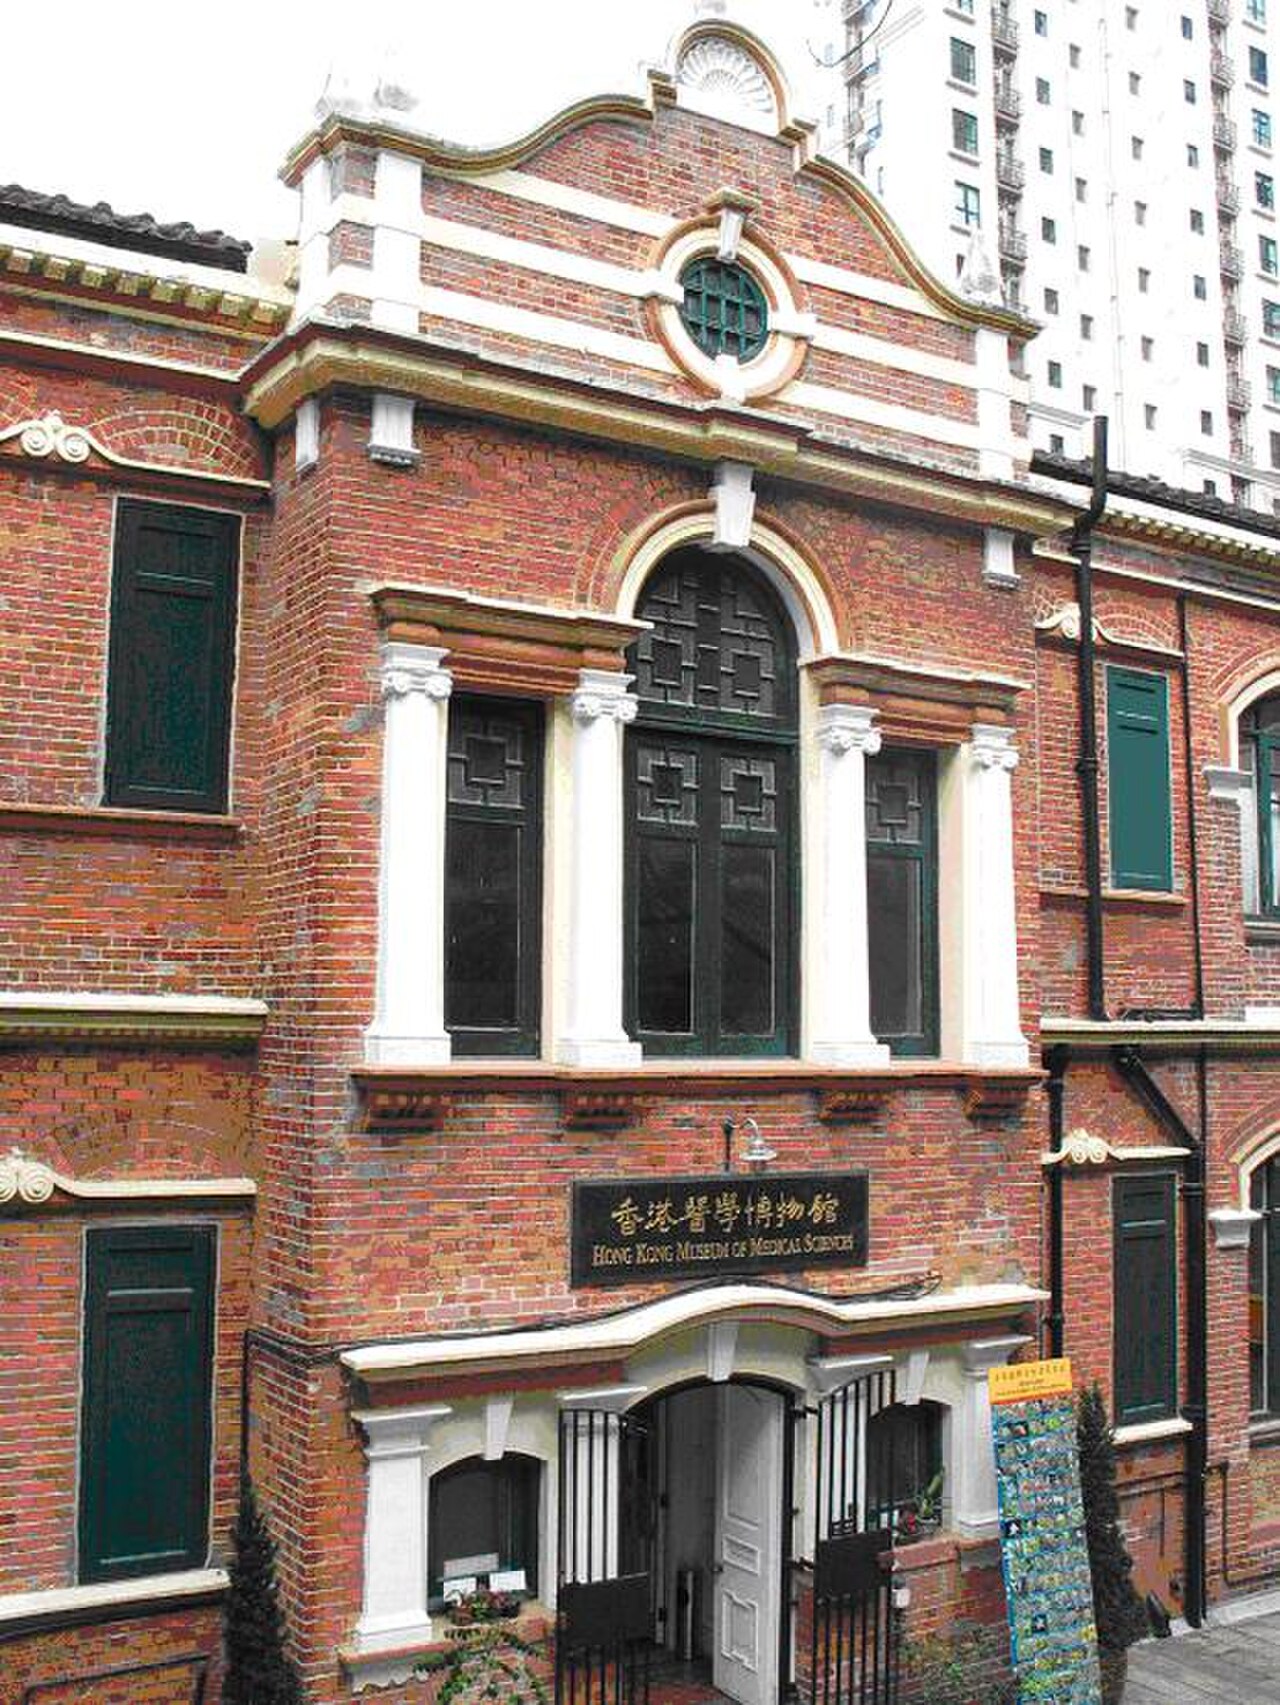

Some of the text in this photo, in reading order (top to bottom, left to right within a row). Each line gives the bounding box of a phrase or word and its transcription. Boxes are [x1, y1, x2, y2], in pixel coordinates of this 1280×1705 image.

[611, 1192, 839, 1236] 香港醫學博物館
[593, 1243, 633, 1267] HONG
[635, 1242, 672, 1265] KONG
